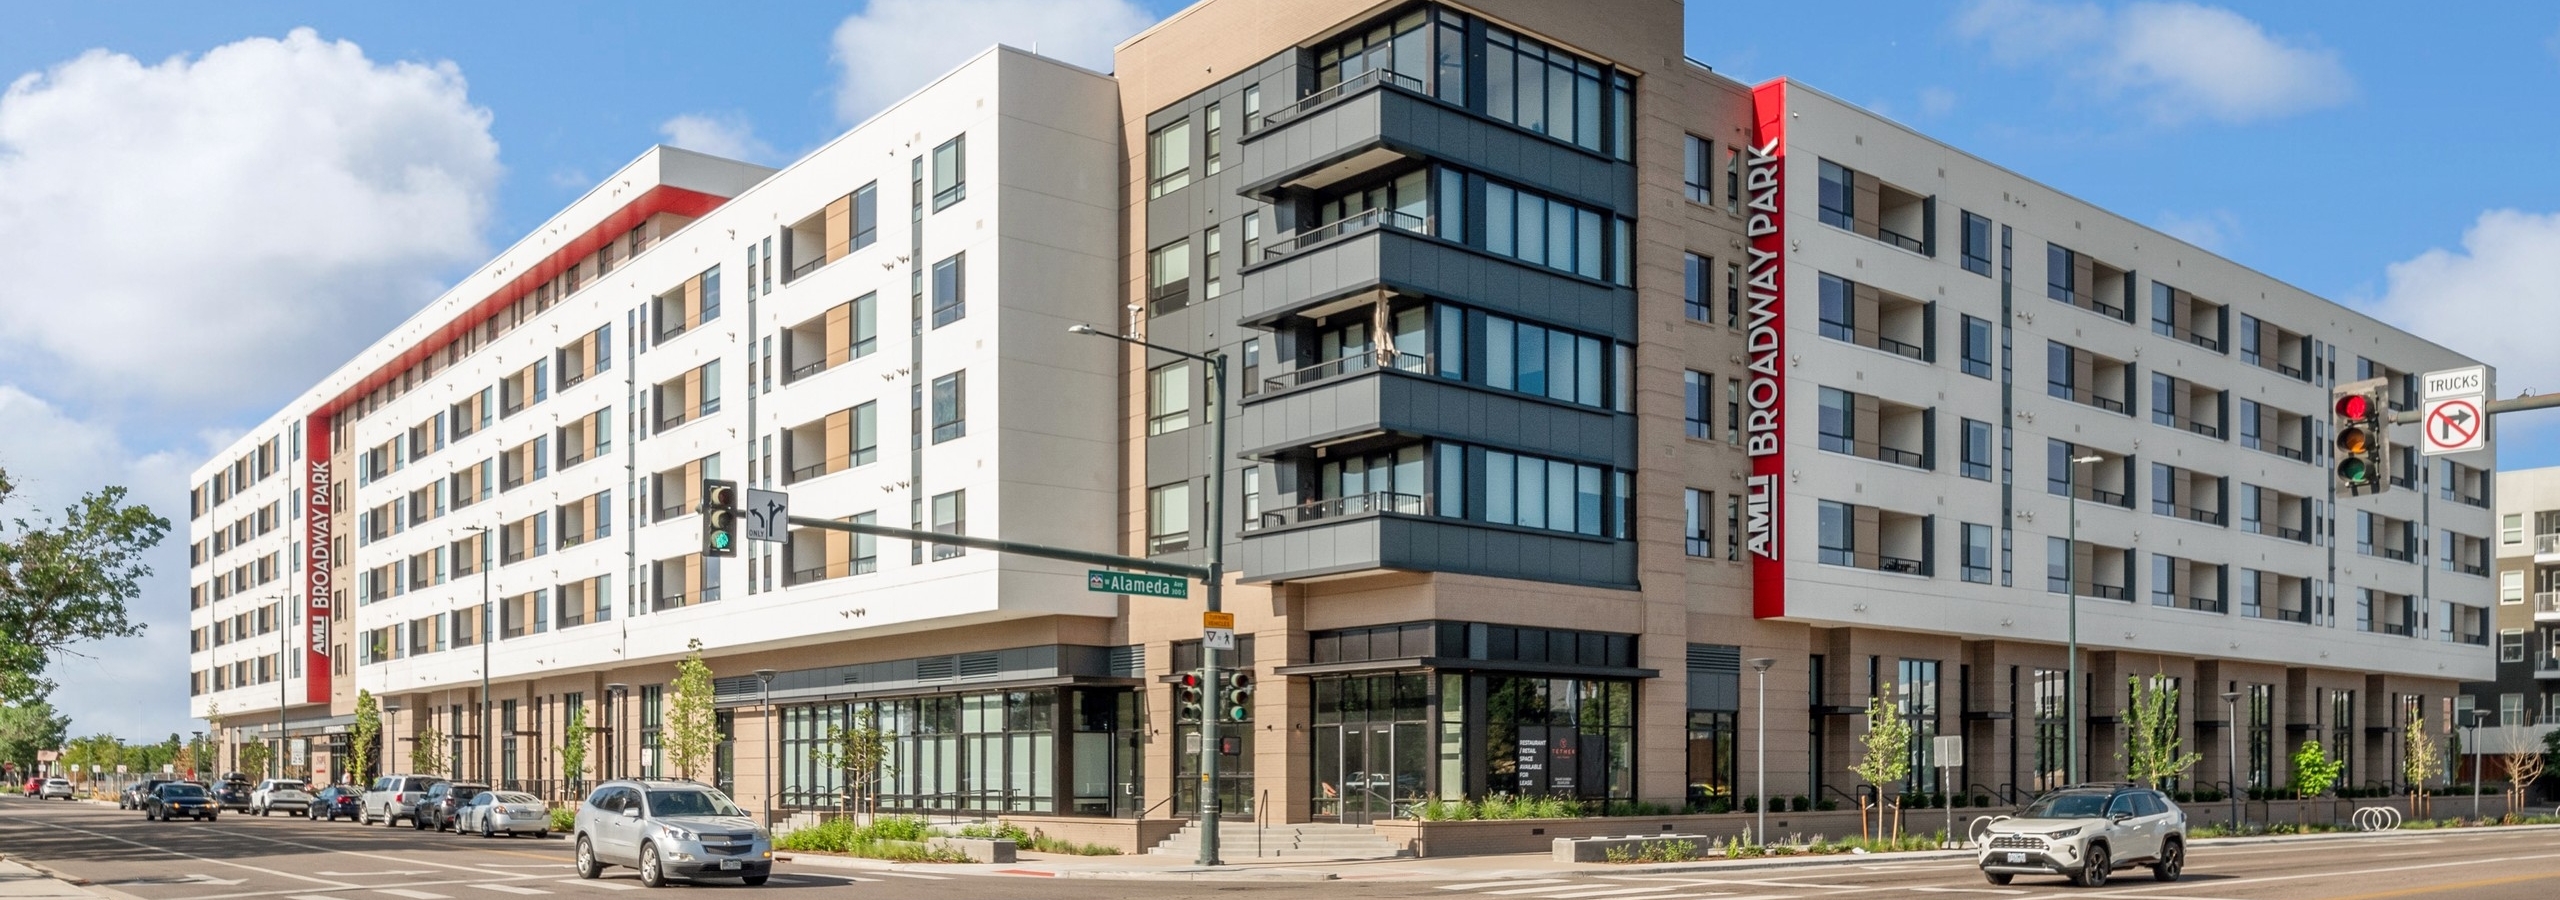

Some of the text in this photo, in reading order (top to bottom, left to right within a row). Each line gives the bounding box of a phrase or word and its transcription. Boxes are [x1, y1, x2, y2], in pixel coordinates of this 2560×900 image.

[1748, 137, 1778, 561] AMLI BROADWAY PARK
[2429, 374, 2478, 392] TRUCKS
[749, 529, 764, 537] ONLY
[312, 460, 329, 657] AMLI BROADWAY PARK
[1111, 576, 1169, 594] Alameda
[1171, 588, 1186, 596] 300 S
[1173, 580, 1184, 588] Ave
